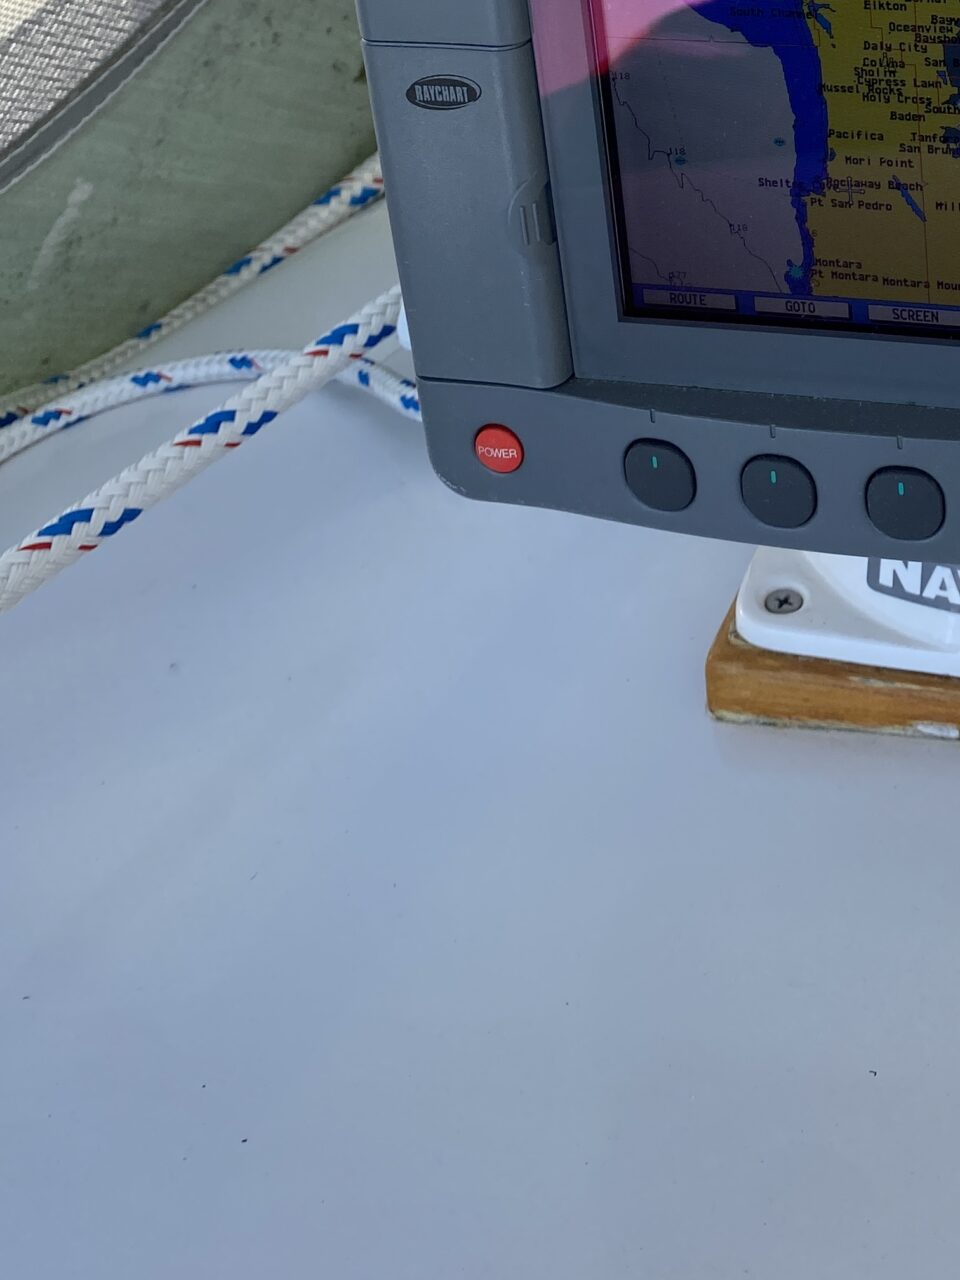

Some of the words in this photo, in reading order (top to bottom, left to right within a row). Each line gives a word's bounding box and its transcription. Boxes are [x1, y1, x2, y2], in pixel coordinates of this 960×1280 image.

[863, 0, 908, 11] Elkton
[888, 21, 954, 34] Oceanview
[863, 40, 892, 53] Daly
[899, 41, 928, 54] City
[924, 57, 947, 68] San
[857, 76, 907, 88] Cypress
[913, 78, 942, 89] Lawn
[414, 84, 469, 103] RAYCHART
[867, 85, 904, 96] Rocks
[862, 93, 891, 104] Holy
[896, 94, 932, 105] Cross
[924, 104, 960, 115] South
[889, 111, 926, 122] Baden
[828, 129, 884, 141] Pacifica
[898, 143, 921, 154] San
[844, 155, 871, 166] Mori
[879, 157, 915, 169] Point
[810, 197, 824, 208] Pt
[830, 198, 851, 209] San
[858, 199, 893, 211] Pedro
[814, 258, 862, 269] Montara
[831, 271, 879, 283] Montara
[881, 276, 930, 289] Montara
[669, 293, 707, 306] ROUTE
[785, 300, 816, 313] GOTO
[892, 308, 940, 323] SCREEN
[478, 445, 518, 458] POWER
